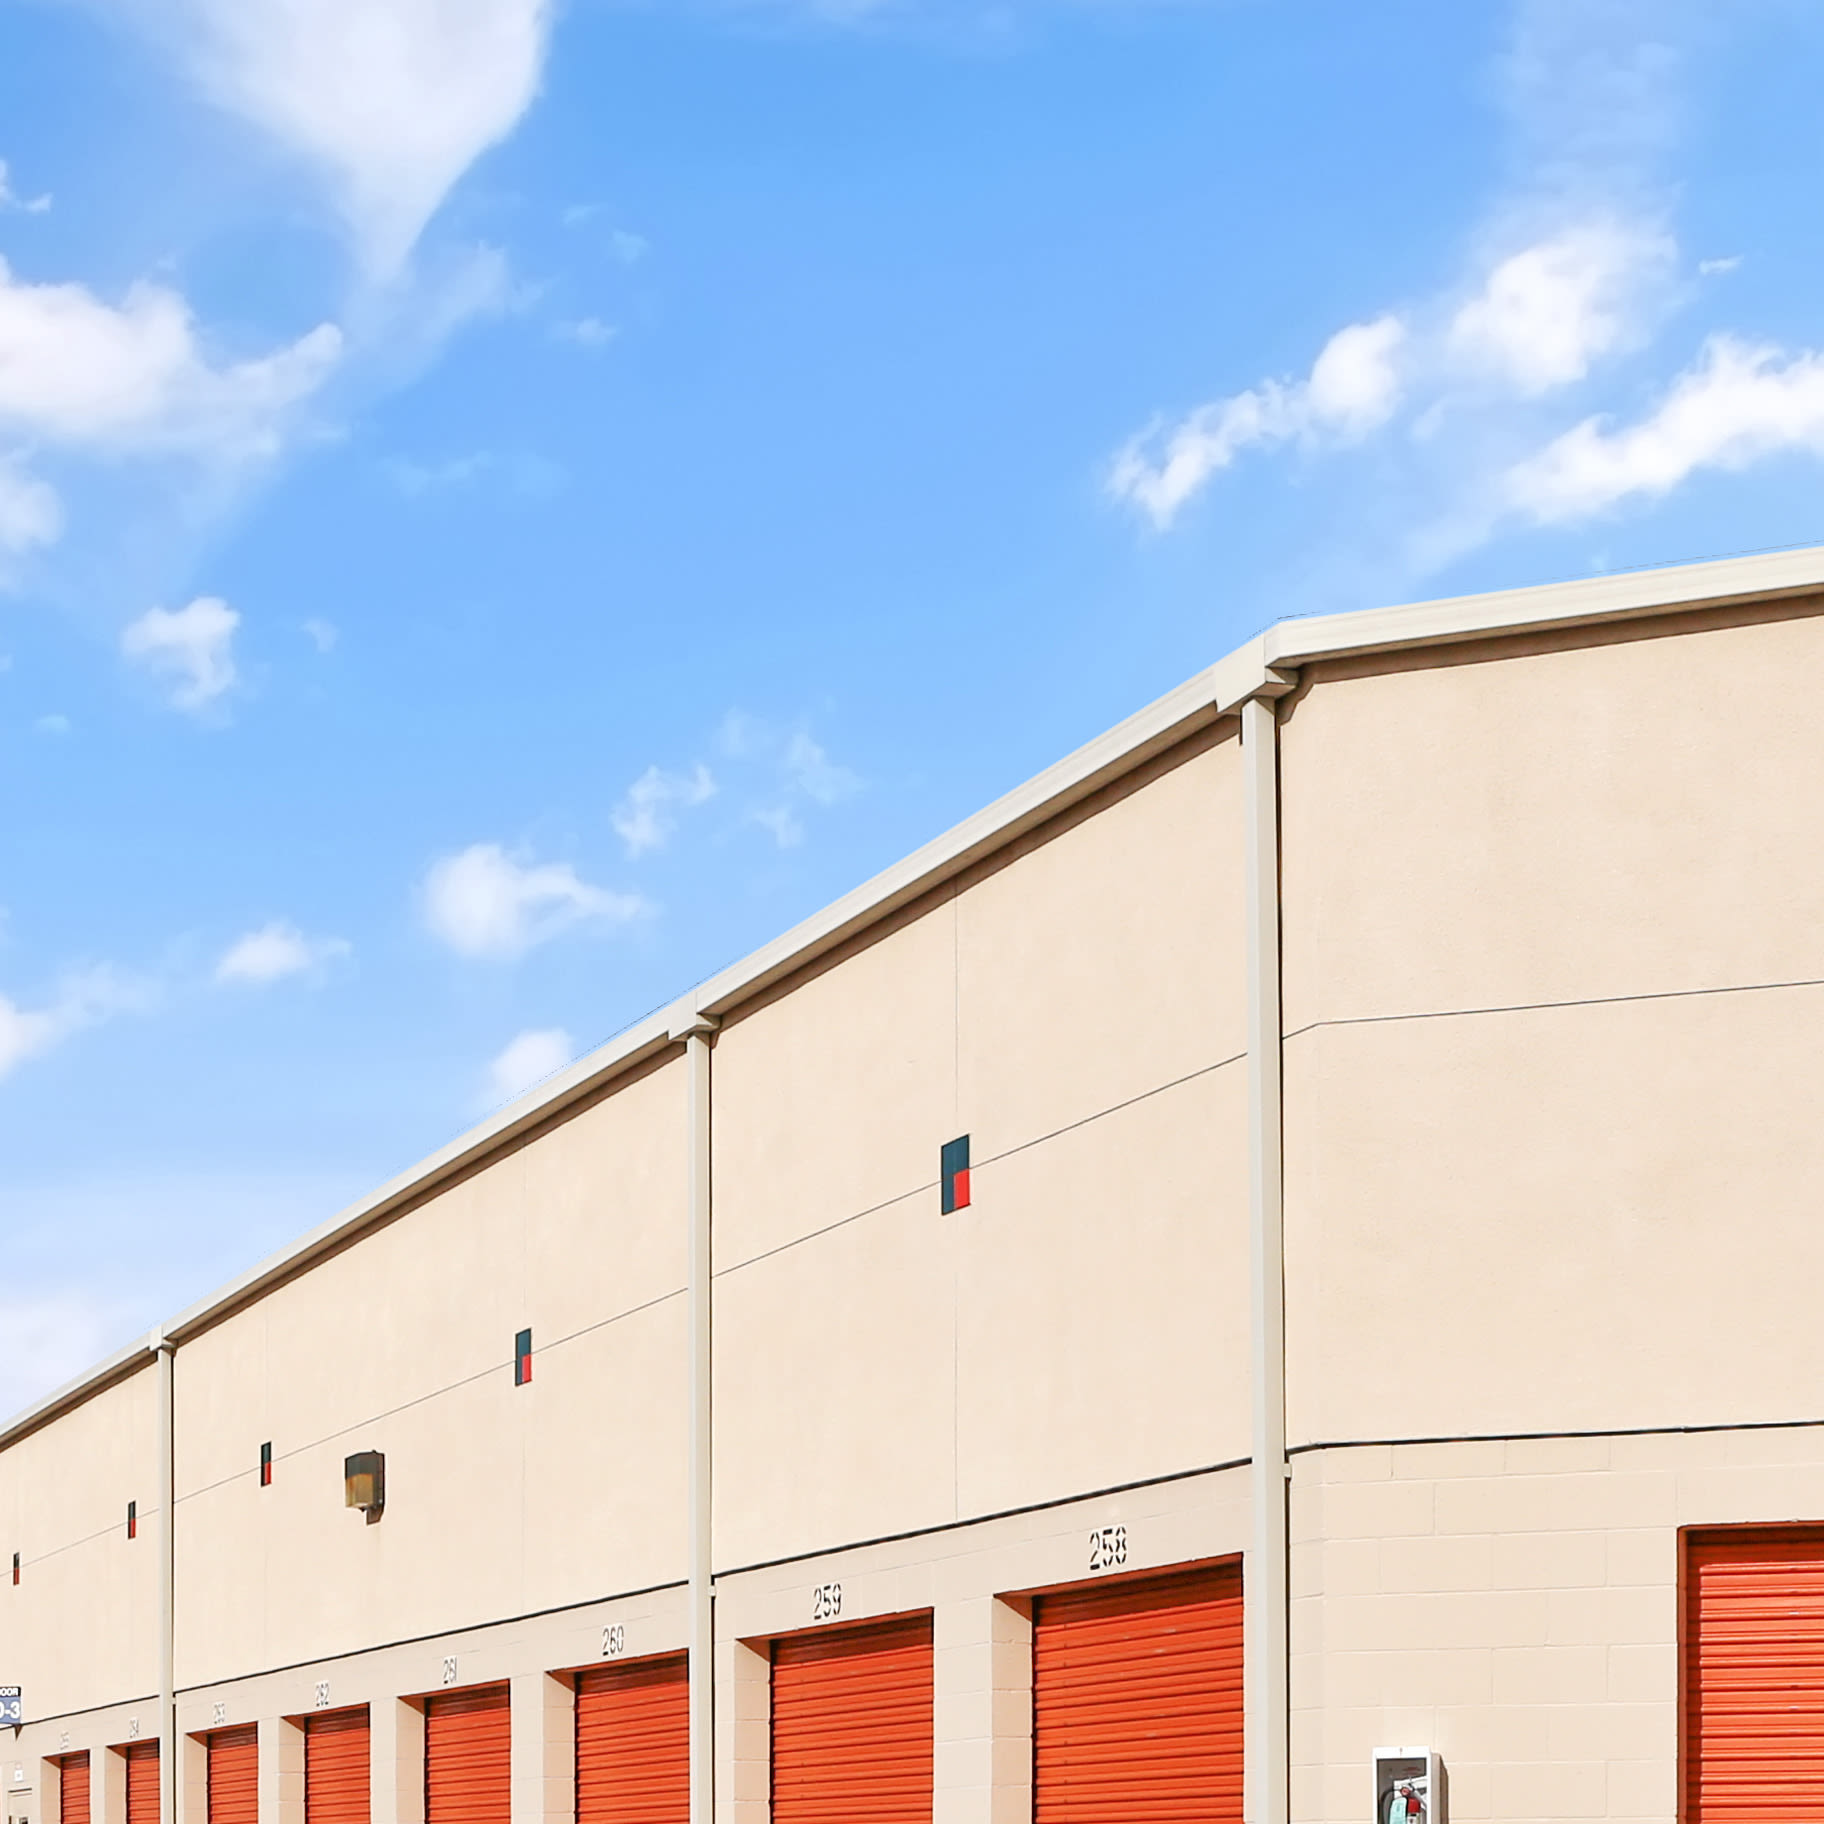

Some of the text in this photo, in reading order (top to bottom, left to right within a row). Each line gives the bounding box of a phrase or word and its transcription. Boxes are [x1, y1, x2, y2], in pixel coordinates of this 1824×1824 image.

[1089, 1526, 1127, 1570] 258
[813, 1583, 842, 1620] 259
[602, 1625, 625, 1656] 260
[443, 1656, 457, 1684] 261
